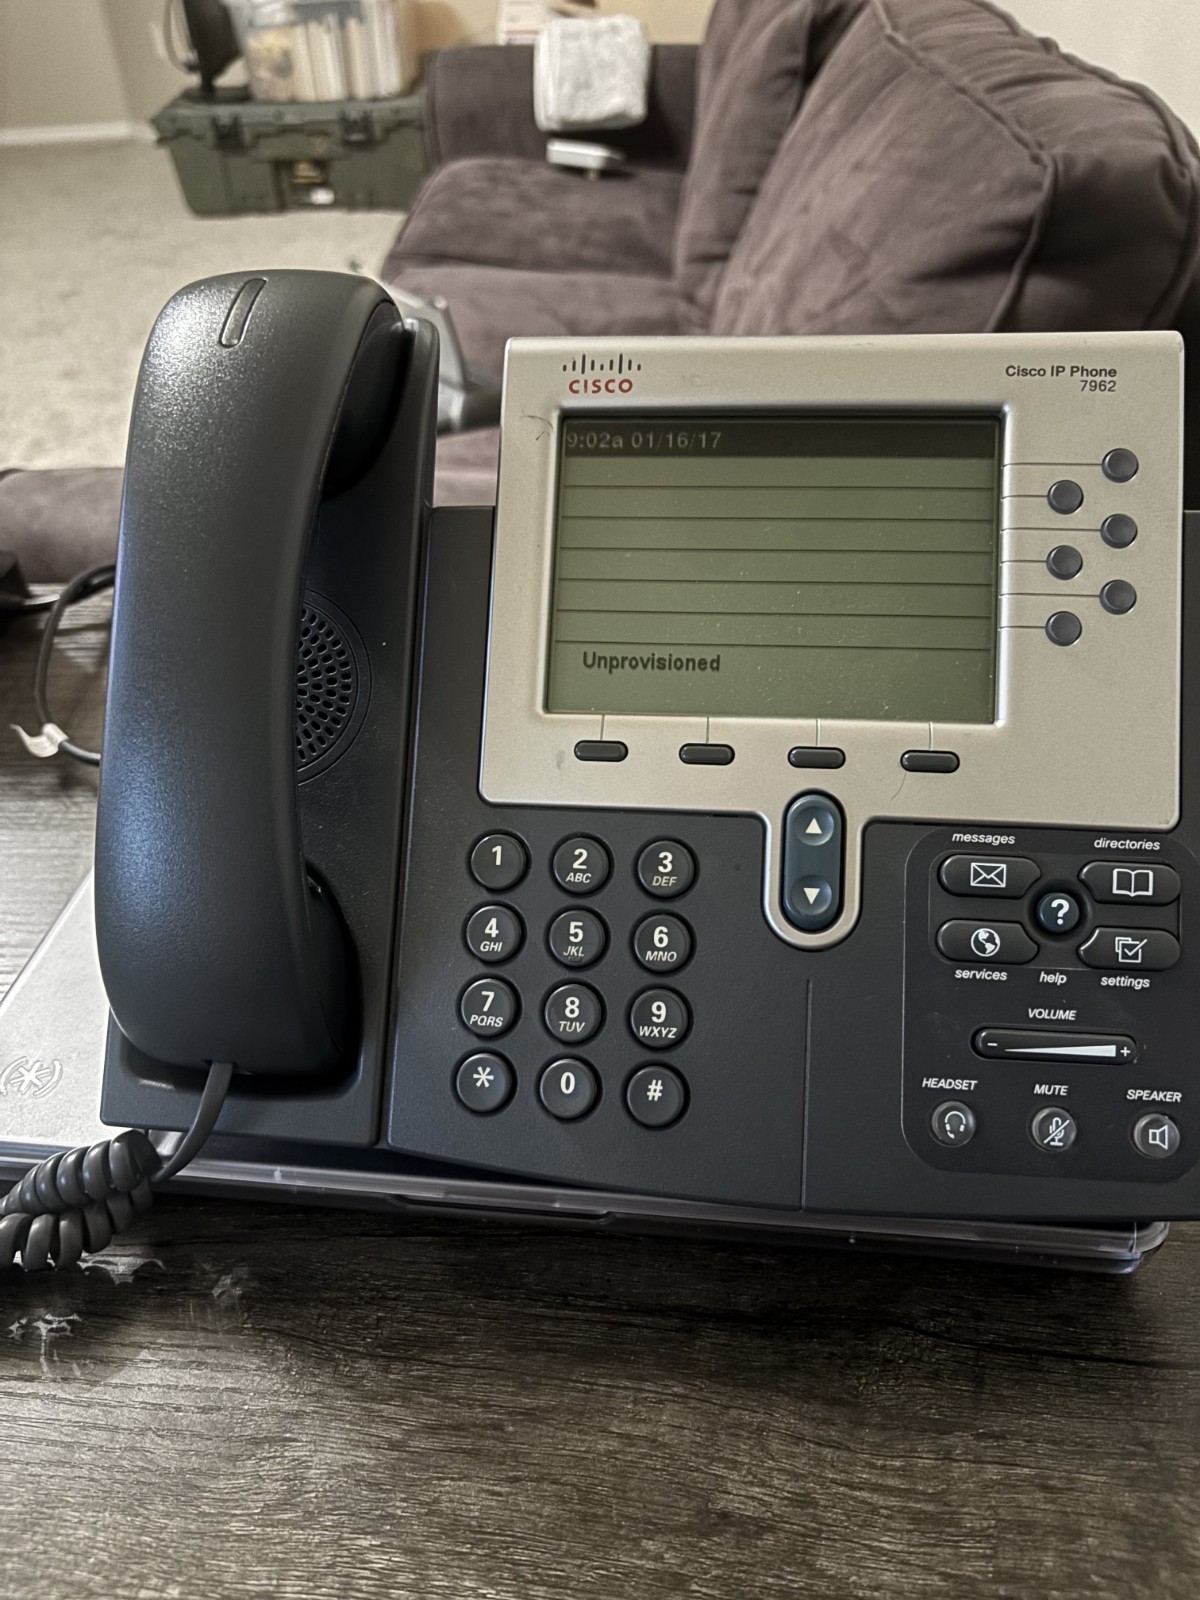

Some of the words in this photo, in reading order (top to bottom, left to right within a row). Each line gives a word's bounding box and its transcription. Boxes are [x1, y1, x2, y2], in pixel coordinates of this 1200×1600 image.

[1005, 365, 1046, 377] Cisco
[1051, 366, 1066, 377] IP
[1070, 366, 1117, 378] Phone
[568, 378, 633, 394] CISCO
[1080, 380, 1117, 392] 7962
[566, 431, 623, 448] 9:02a
[631, 431, 722, 448] 01/16/17
[582, 651, 721, 675] Unprovisioned
[951, 832, 1016, 845] messages
[1093, 837, 1161, 851] directories
[492, 845, 502, 866] 1
[572, 848, 588, 870] 2
[657, 851, 673, 873] 3
[565, 872, 592, 884] ABC
[652, 876, 677, 887] DEF
[1051, 898, 1070, 925] ?
[484, 917, 499, 938] 4
[568, 921, 584, 943] 5
[653, 926, 669, 948] 6
[479, 941, 503, 952] GHI
[563, 946, 585, 957] JKL
[645, 951, 677, 962] MNO
[954, 968, 1008, 981] services
[1039, 972, 1067, 985] help
[1100, 975, 1151, 990] settings
[480, 991, 495, 1012] 7
[564, 996, 580, 1019] 8
[651, 1001, 667, 1024] 9
[1027, 1008, 1077, 1021] VOLUME
[469, 1015, 504, 1028] PQRS
[558, 1021, 586, 1033] TUV
[639, 1026, 678, 1038] WXYZ
[560, 1072, 576, 1094] 0
[921, 1077, 978, 1091] HEADSET
[1033, 1084, 1069, 1096] MUTE
[646, 1079, 664, 1102] #
[1126, 1089, 1182, 1103] SPEAKER
